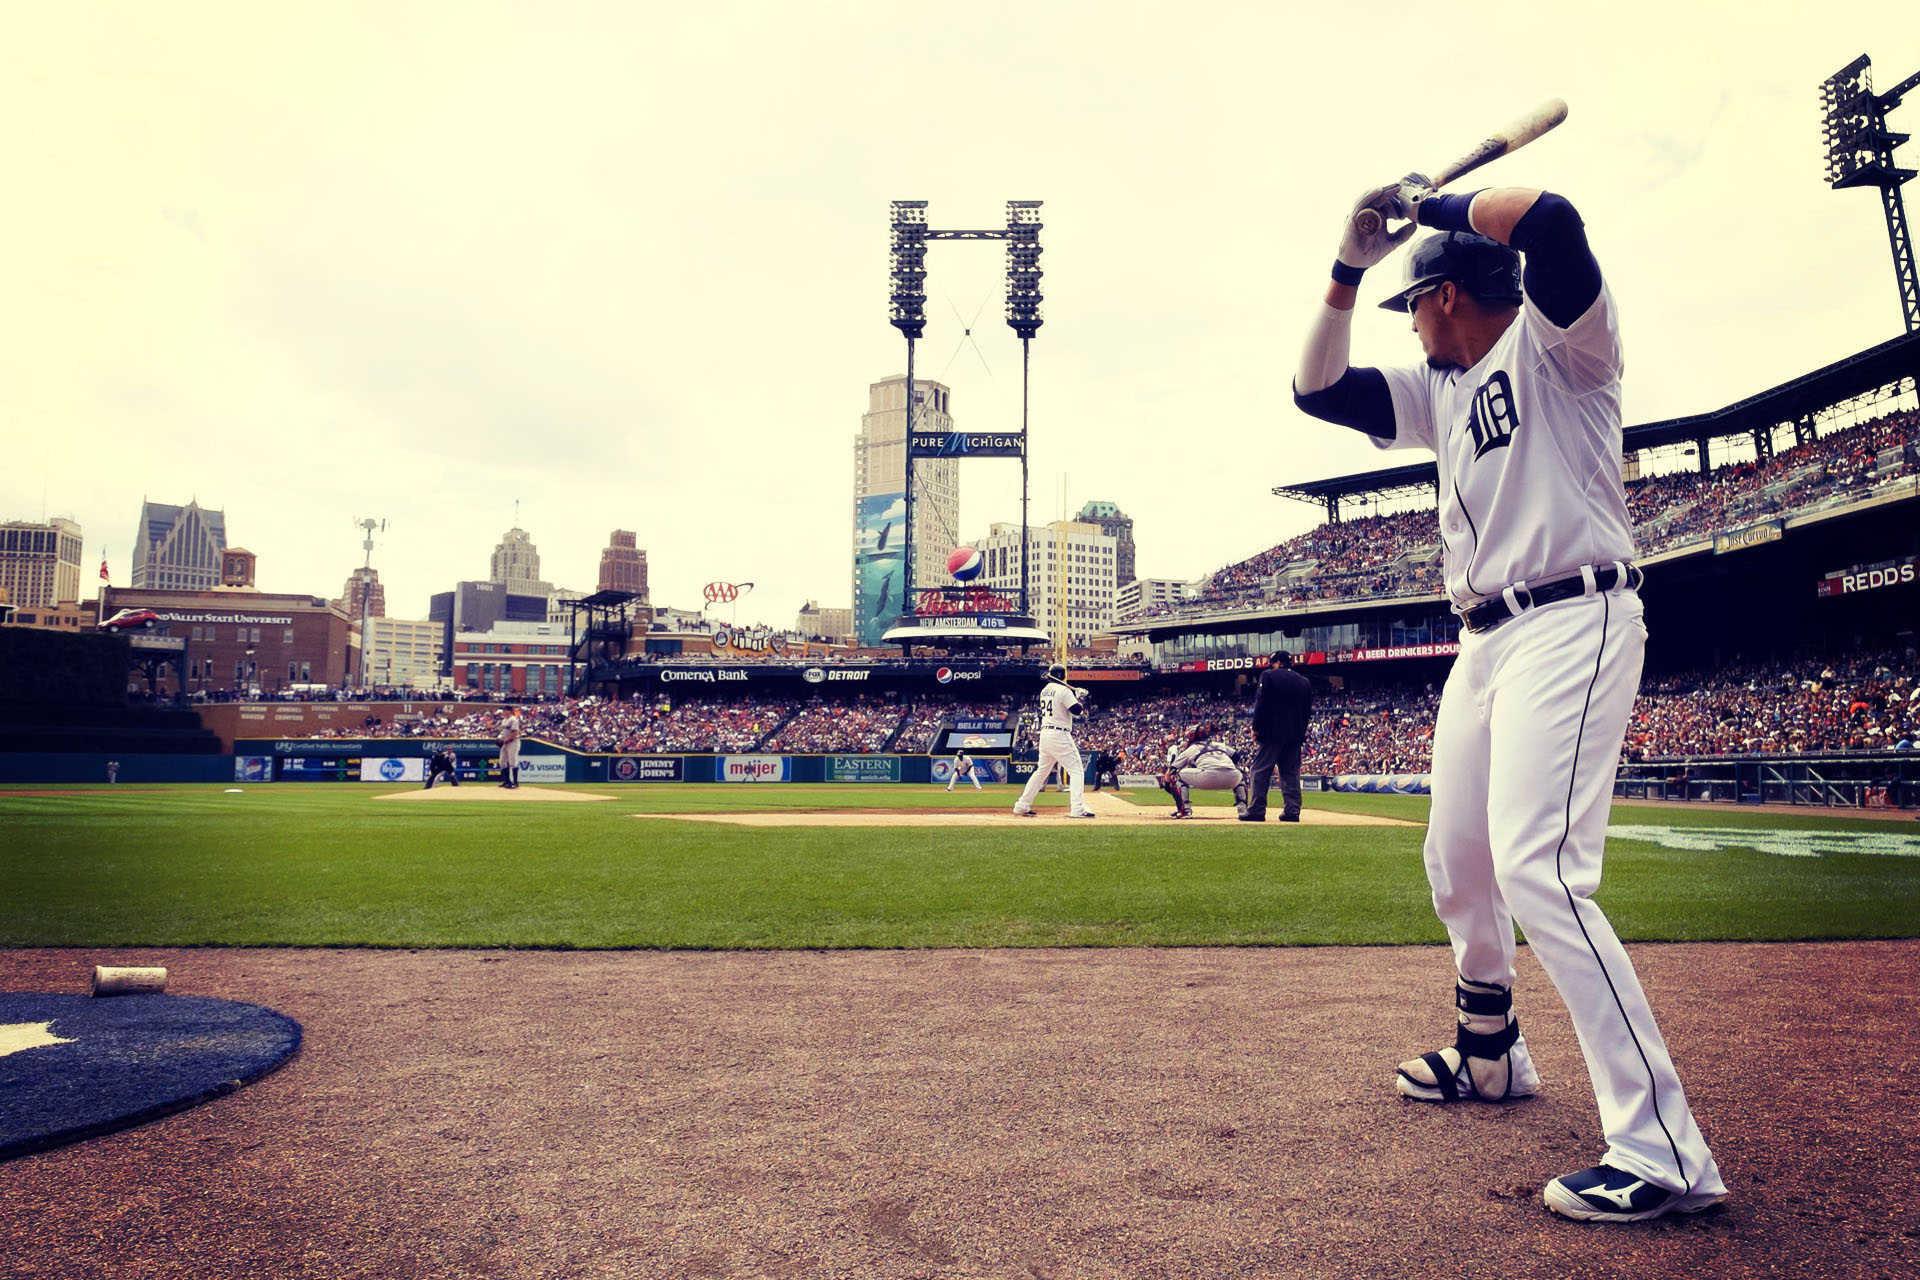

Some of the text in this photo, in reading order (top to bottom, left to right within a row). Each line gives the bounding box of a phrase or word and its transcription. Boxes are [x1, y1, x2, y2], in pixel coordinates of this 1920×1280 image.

[912, 432, 1021, 456] PURE MICHIGAN
[705, 582, 737, 602] AAA
[169, 612, 204, 622] VALLEY
[205, 613, 234, 623] STATE
[234, 614, 293, 625] UNIVERSITY
[934, 617, 978, 628] AMSTERDAM
[1357, 651, 1365, 660] A
[1365, 650, 1387, 660] BEER
[1387, 645, 1433, 658] DRINKERS
[717, 669, 749, 681] Bank
[828, 670, 871, 681] DETROIT
[953, 670, 982, 681] pepsi
[1040, 700, 1053, 717] 24
[537, 763, 565, 772] VISION
[640, 760, 675, 769] JIMMY
[834, 757, 892, 770] EASTERN
[640, 769, 675, 779] JOHN'S
